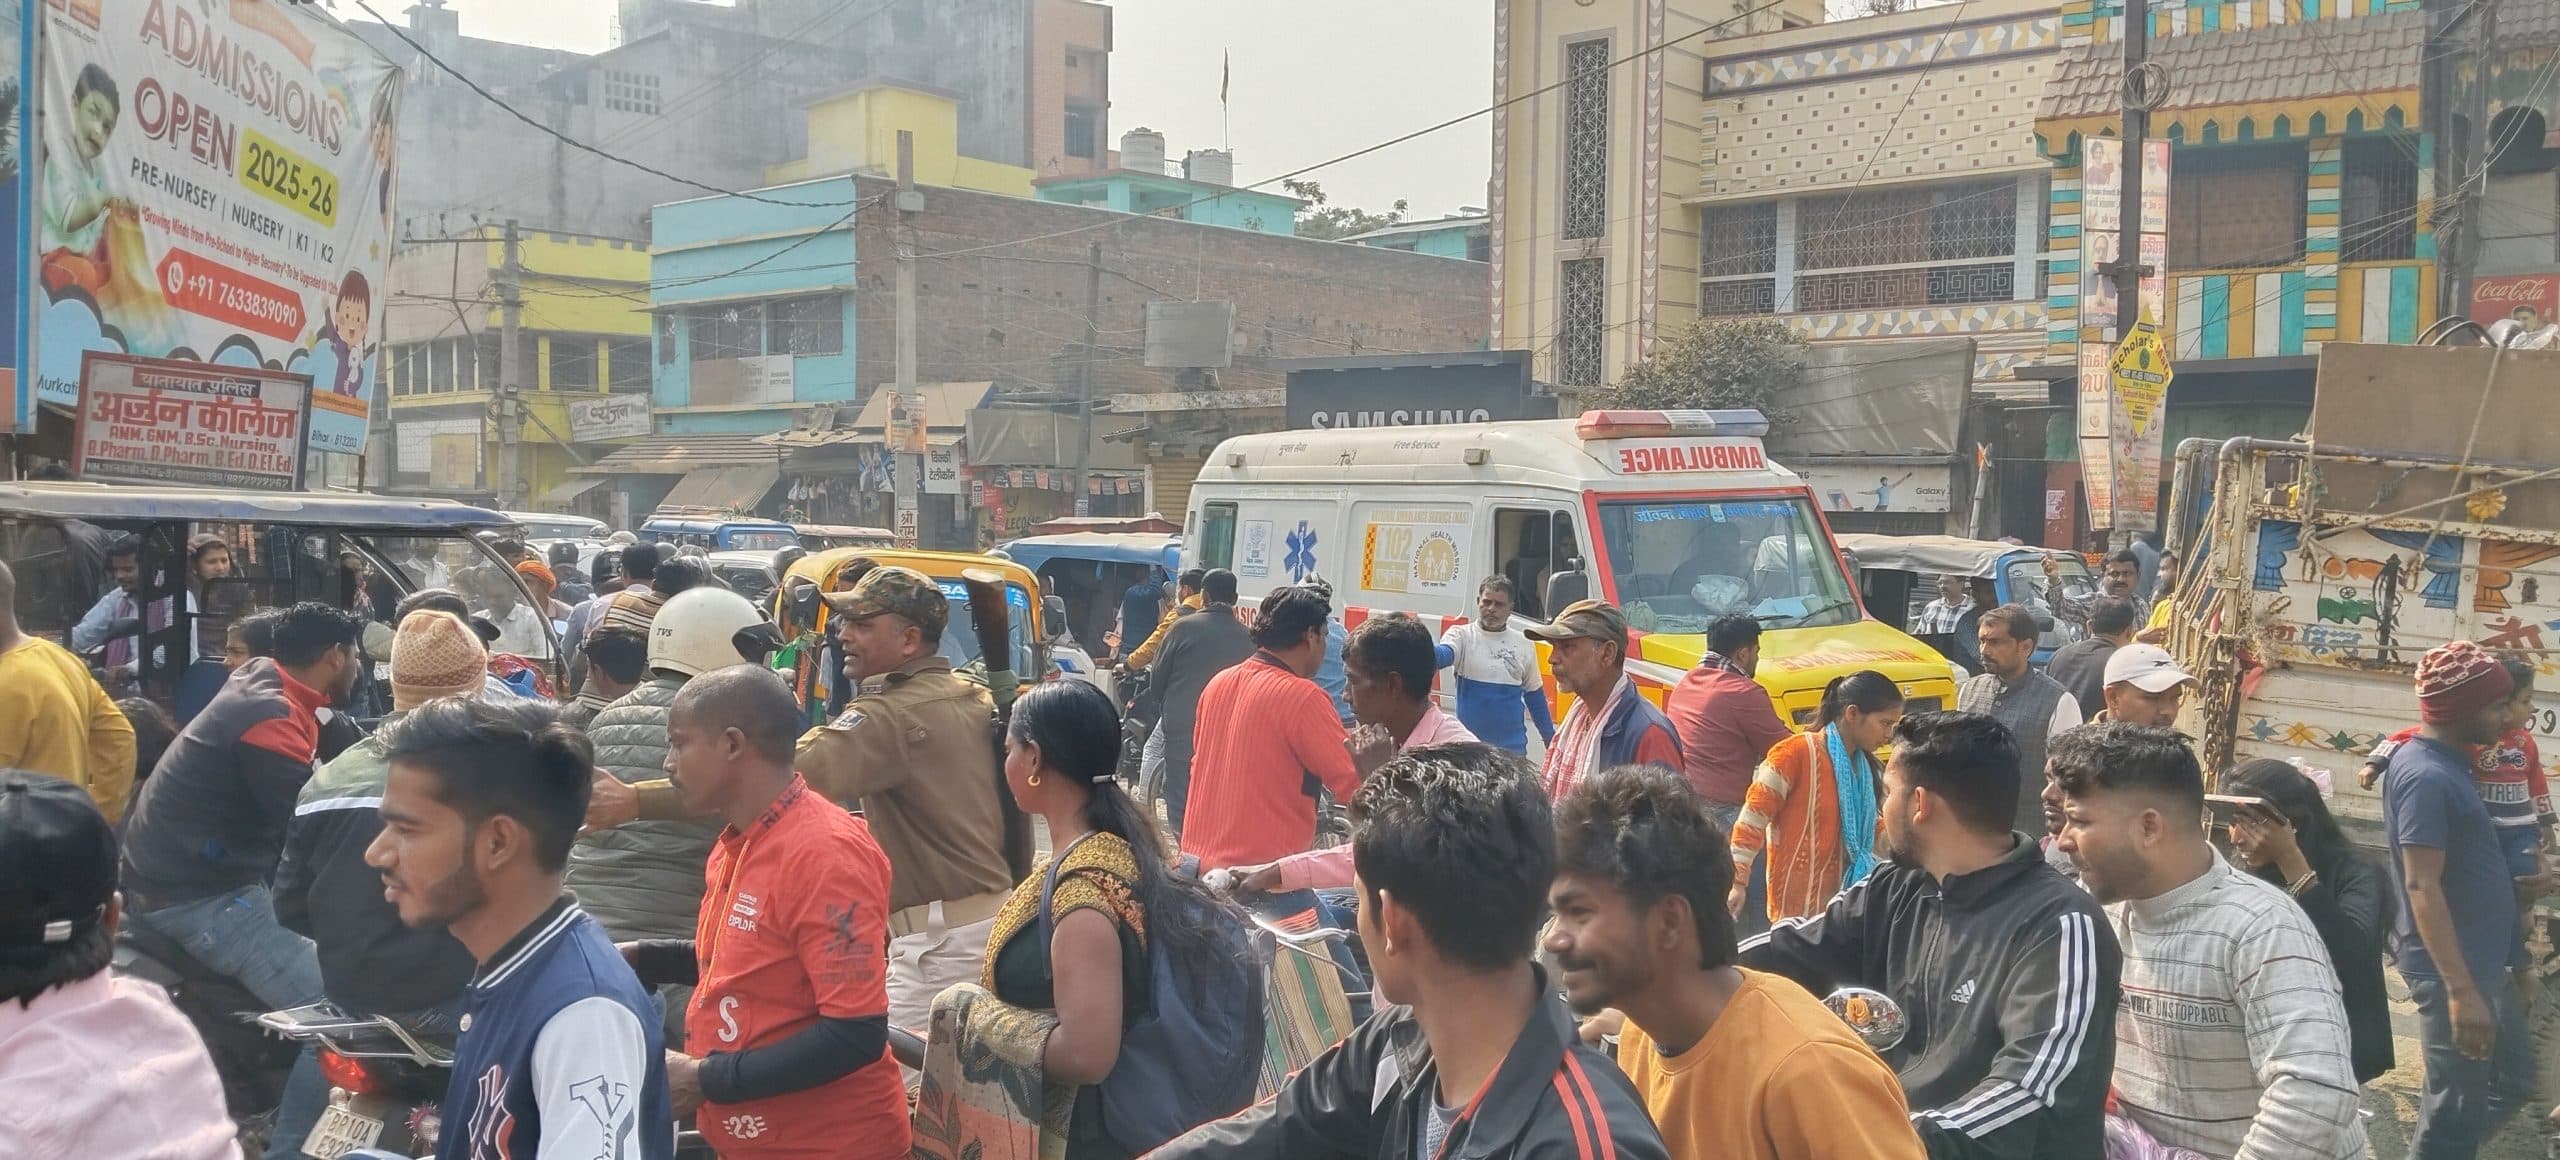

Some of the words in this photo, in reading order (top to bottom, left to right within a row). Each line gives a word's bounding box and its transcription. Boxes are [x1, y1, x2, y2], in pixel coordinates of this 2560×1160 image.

[139, 0, 342, 155] ADMISSIONS
[135, 77, 237, 177] OPEN
[245, 142, 334, 217] 2025-26
[131, 157, 217, 214] PRE-NURSEY
[231, 204, 284, 241] NURSERY
[297, 231, 309, 253] K1
[321, 242, 335, 264] K2
[187, 276, 214, 301] +91
[218, 283, 297, 328] 7633839090
[2112, 335, 2154, 374] Scholar's
[91, 388, 193, 429] अर्जुन
[196, 393, 299, 439] कॉलेज
[1392, 440, 1411, 450] Free
[1411, 440, 1441, 450] Service
[1915, 487, 1946, 496] Galaxy
[656, 627, 673, 637] TVS
[1233, 605, 1258, 627] ASIC
[717, 996, 739, 1043] S
[2156, 1000, 2232, 1024] UNSTOPPABLE
[729, 1114, 761, 1140] 23
